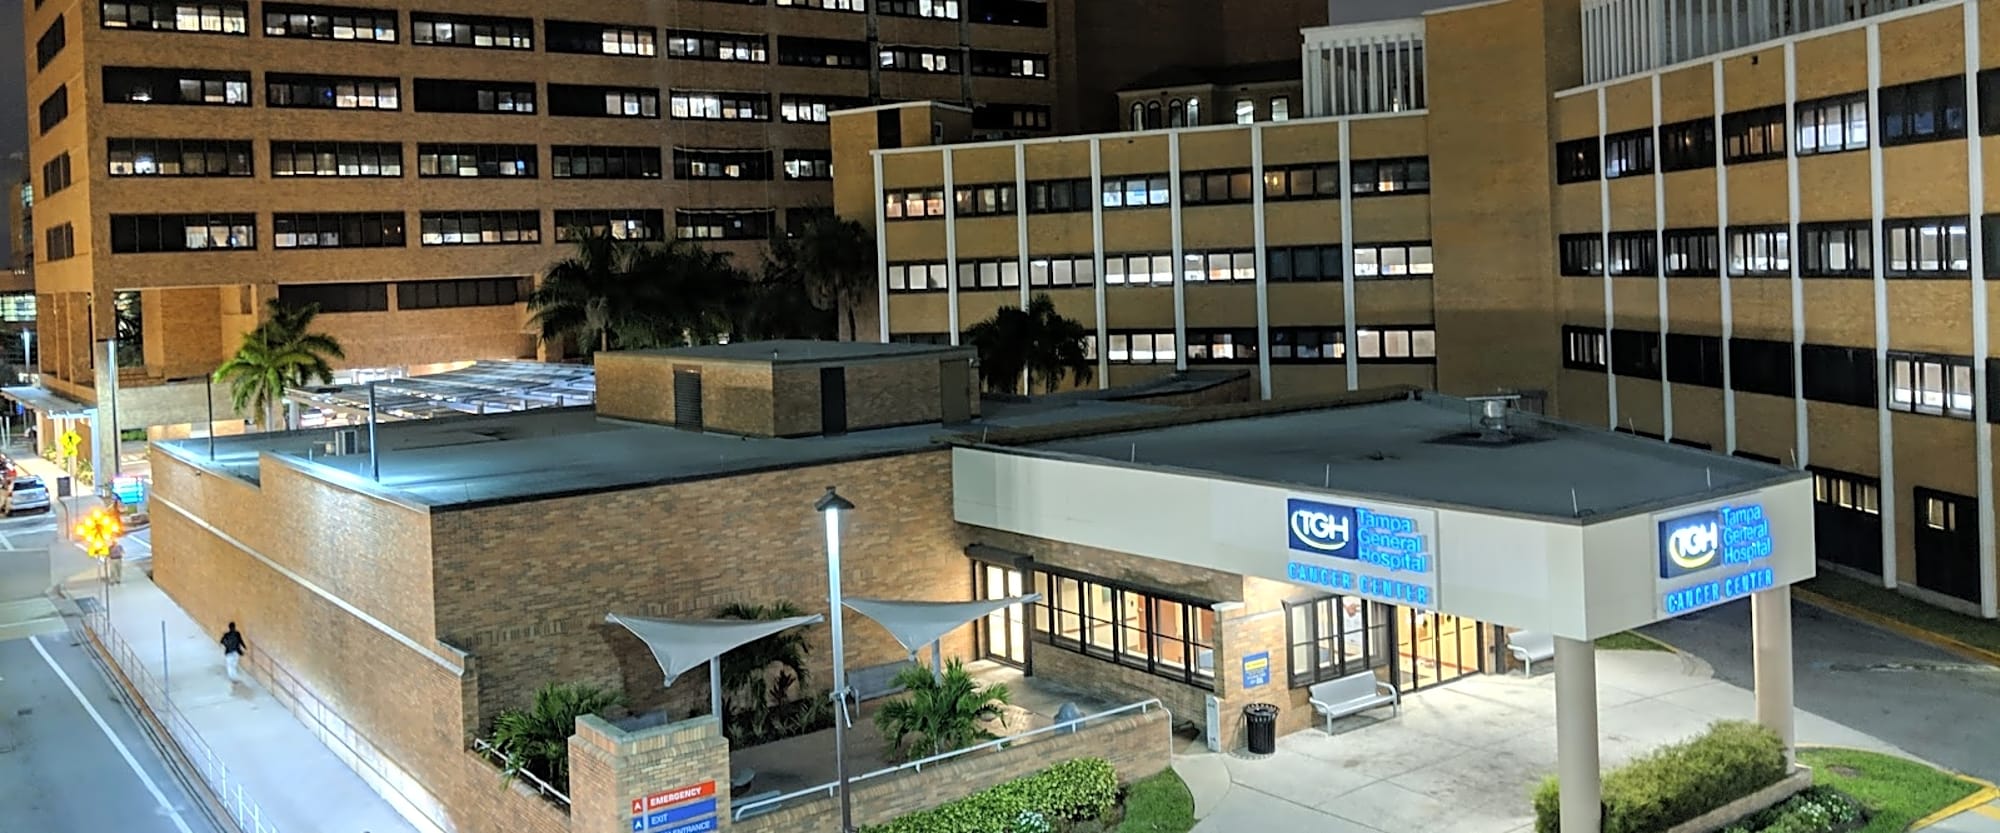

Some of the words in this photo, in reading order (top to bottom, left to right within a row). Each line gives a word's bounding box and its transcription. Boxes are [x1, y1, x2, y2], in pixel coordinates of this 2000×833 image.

[1298, 508, 1349, 541] TGH
[1356, 508, 1412, 533] Tampa
[1722, 505, 1761, 526] Tampa
[1358, 528, 1422, 553] General
[1673, 521, 1718, 557] TGH
[1723, 519, 1768, 545] General
[1358, 547, 1427, 573] Hospital
[1724, 538, 1772, 565] Hospital
[1287, 562, 1352, 589] CANCER
[1358, 575, 1427, 604] CENTER
[1667, 582, 1720, 613] CANCER
[1725, 569, 1773, 597] CENTER
[650, 786, 702, 807] EMERGENCY
[651, 813, 668, 825] EXIT
